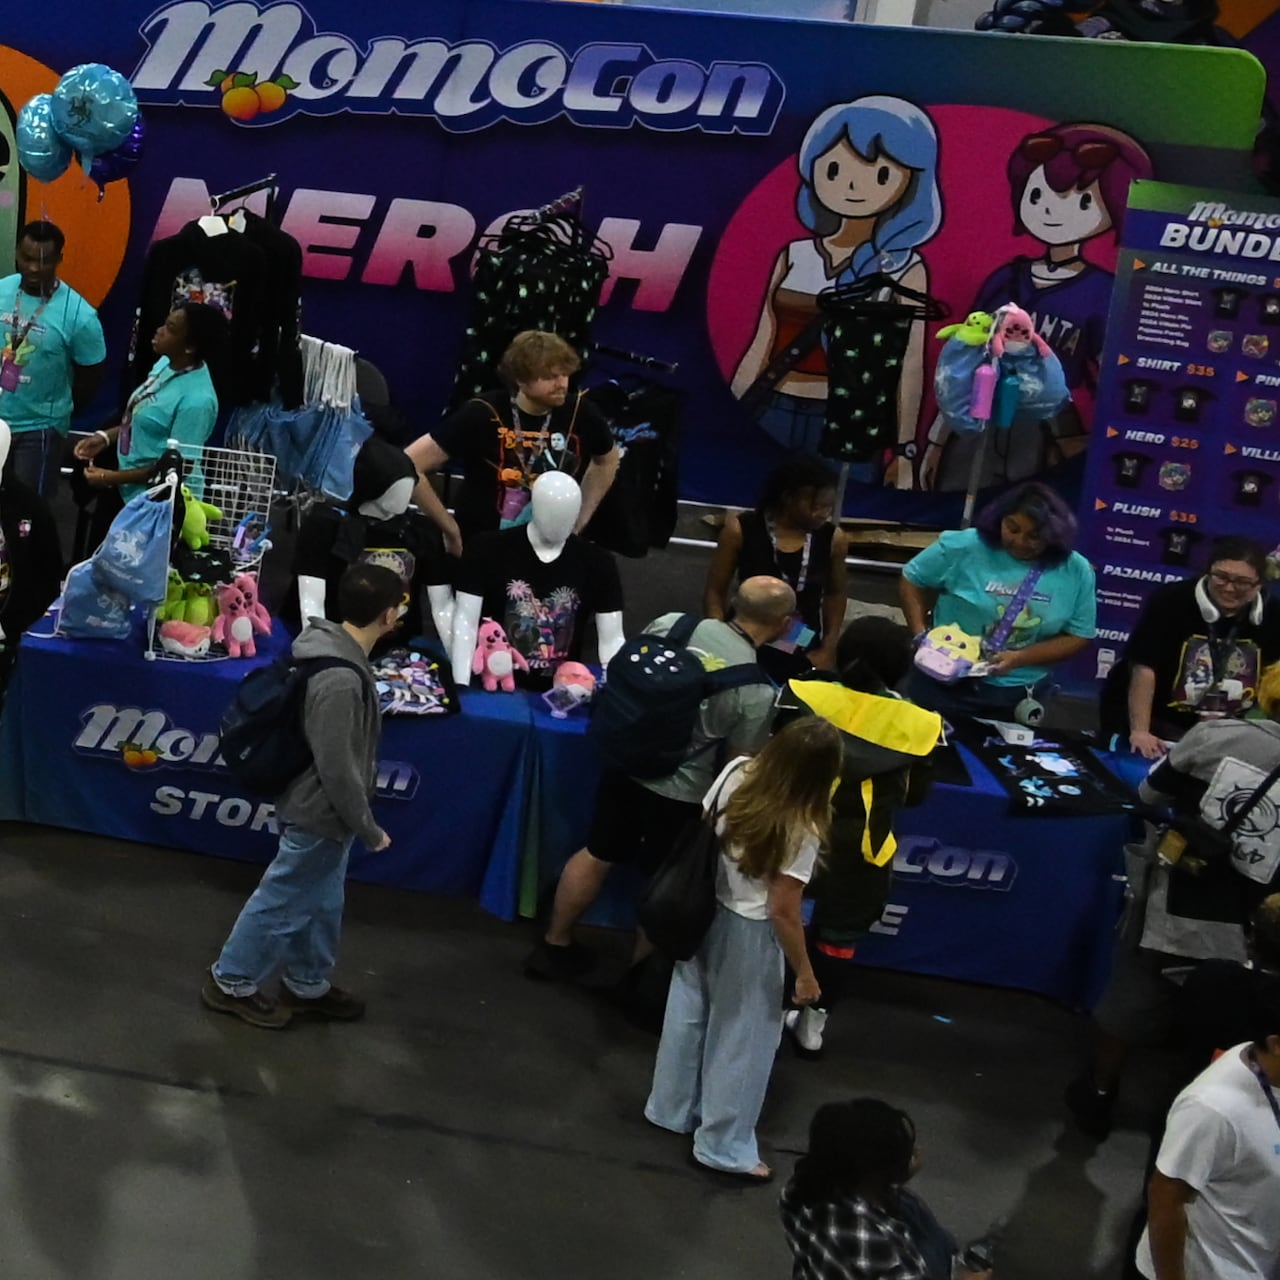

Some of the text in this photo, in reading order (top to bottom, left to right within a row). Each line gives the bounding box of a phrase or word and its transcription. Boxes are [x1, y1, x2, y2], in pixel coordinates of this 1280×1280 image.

[131, 3, 773, 118] MomoCon
[1150, 262, 1267, 285] ALL THE THINGS
[1137, 357, 1215, 377] SHIRT $35
[1125, 430, 1199, 449] HERO $25
[1113, 502, 1161, 518] PLUSH
[1103, 565, 1162, 582] PAJAMA
[1096, 628, 1129, 642] HIGH
[150, 785, 281, 835] STOR
